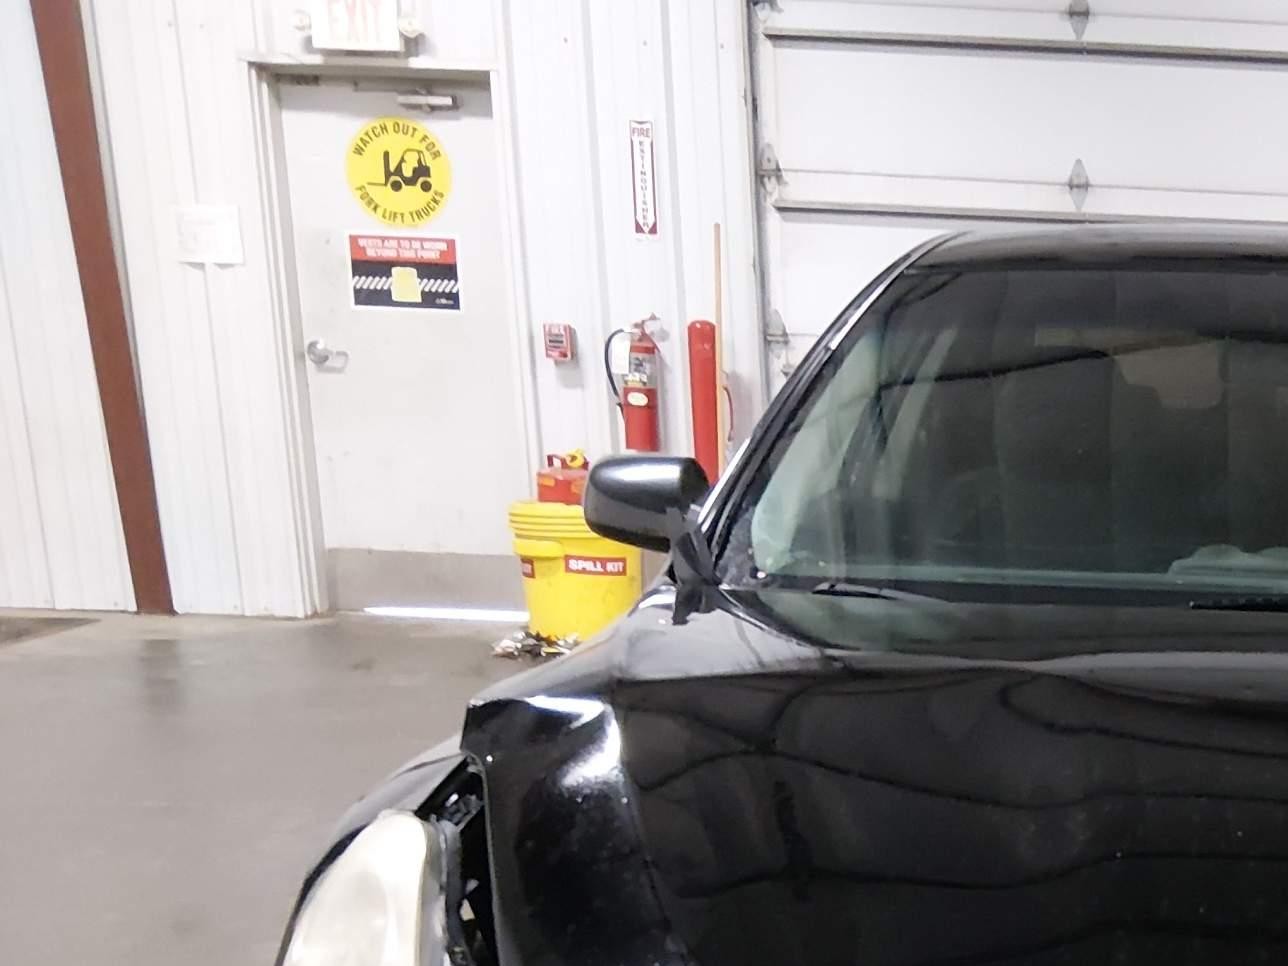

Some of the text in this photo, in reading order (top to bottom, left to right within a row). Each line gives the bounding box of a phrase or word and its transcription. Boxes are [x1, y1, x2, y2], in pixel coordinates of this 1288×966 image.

[352, 121, 442, 160] WATCH OUT FOR
[631, 127, 651, 138] FIRE
[638, 139, 650, 229] EXTINGUISHER
[355, 185, 445, 224] FORK LIFT TRUCKS
[568, 559, 624, 573] SPILL KIT
